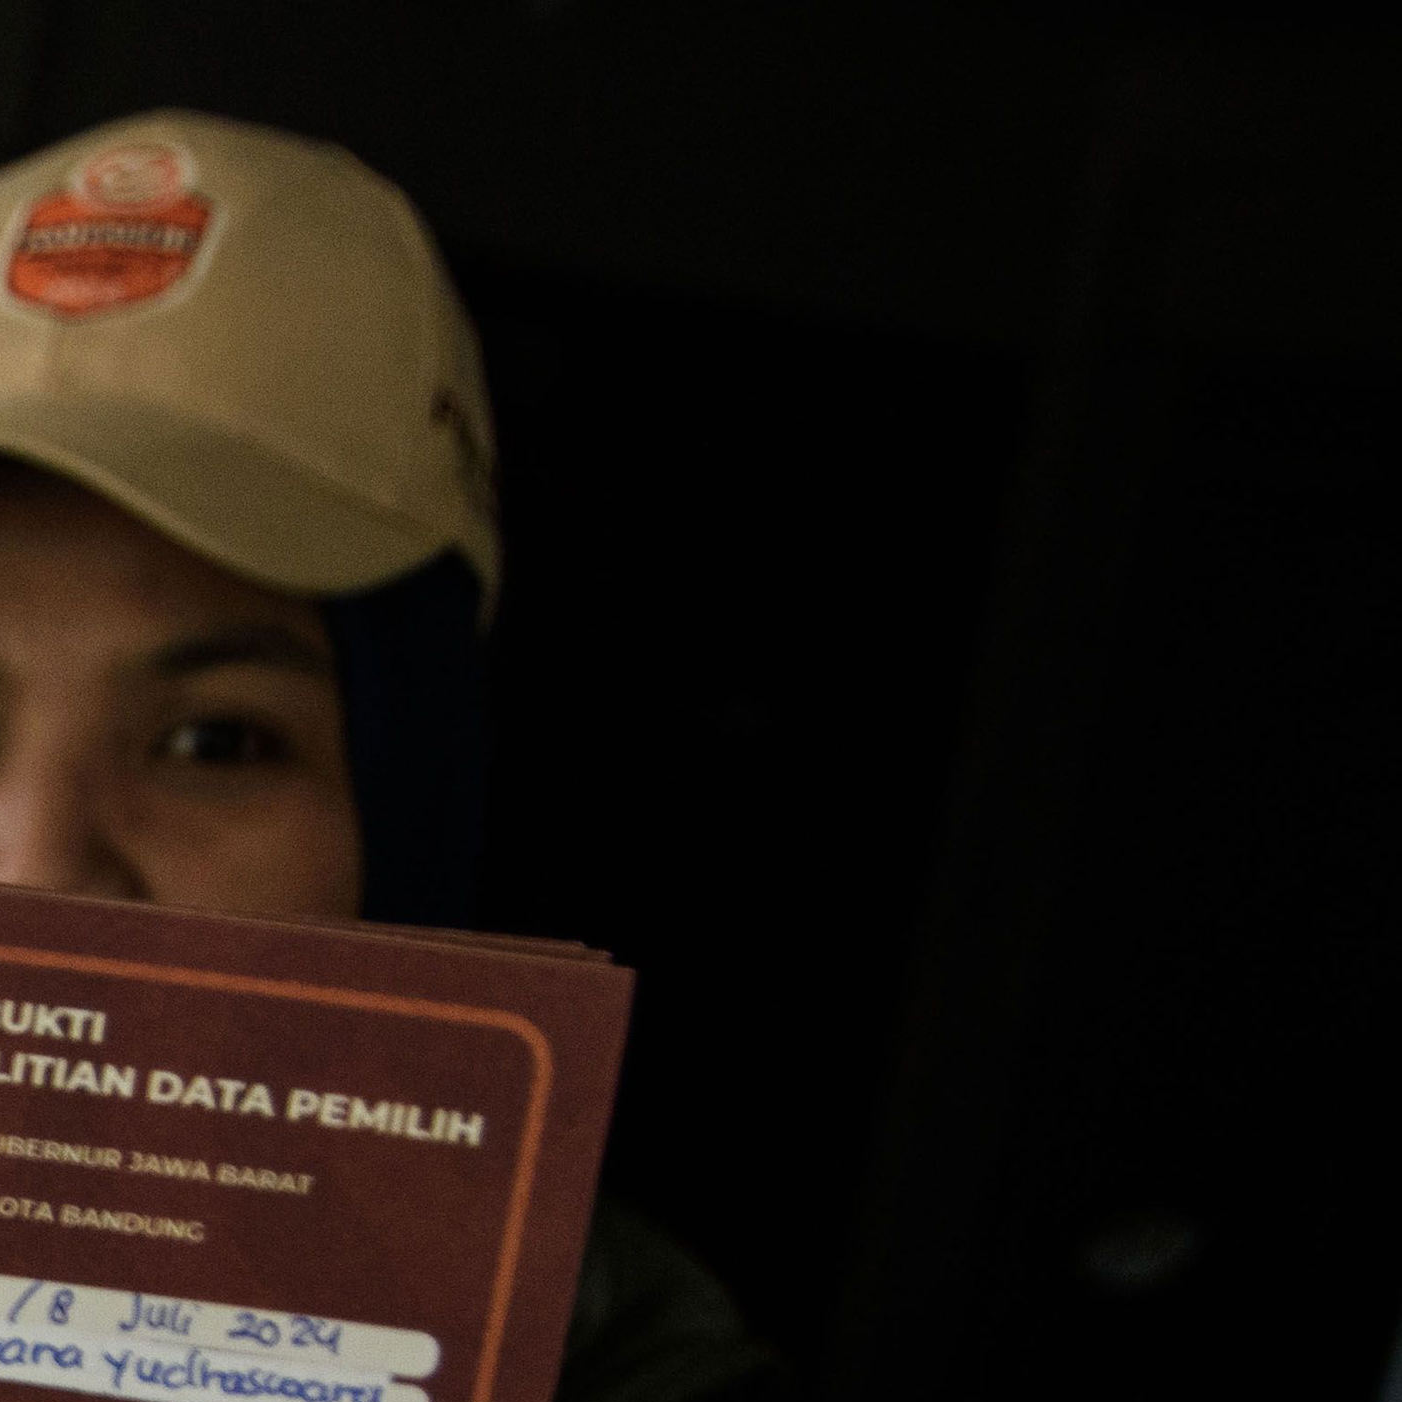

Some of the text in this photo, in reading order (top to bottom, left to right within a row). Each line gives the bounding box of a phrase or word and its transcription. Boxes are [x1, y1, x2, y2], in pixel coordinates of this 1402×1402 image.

[146, 1069, 274, 1118] DATA
[286, 1087, 484, 1147] PEMILIH
[127, 1149, 211, 1182] JAWA
[215, 1163, 314, 1196] BARAT
[60, 1203, 205, 1244] BANDUNG
[225, 1311, 343, 1355] 2024
